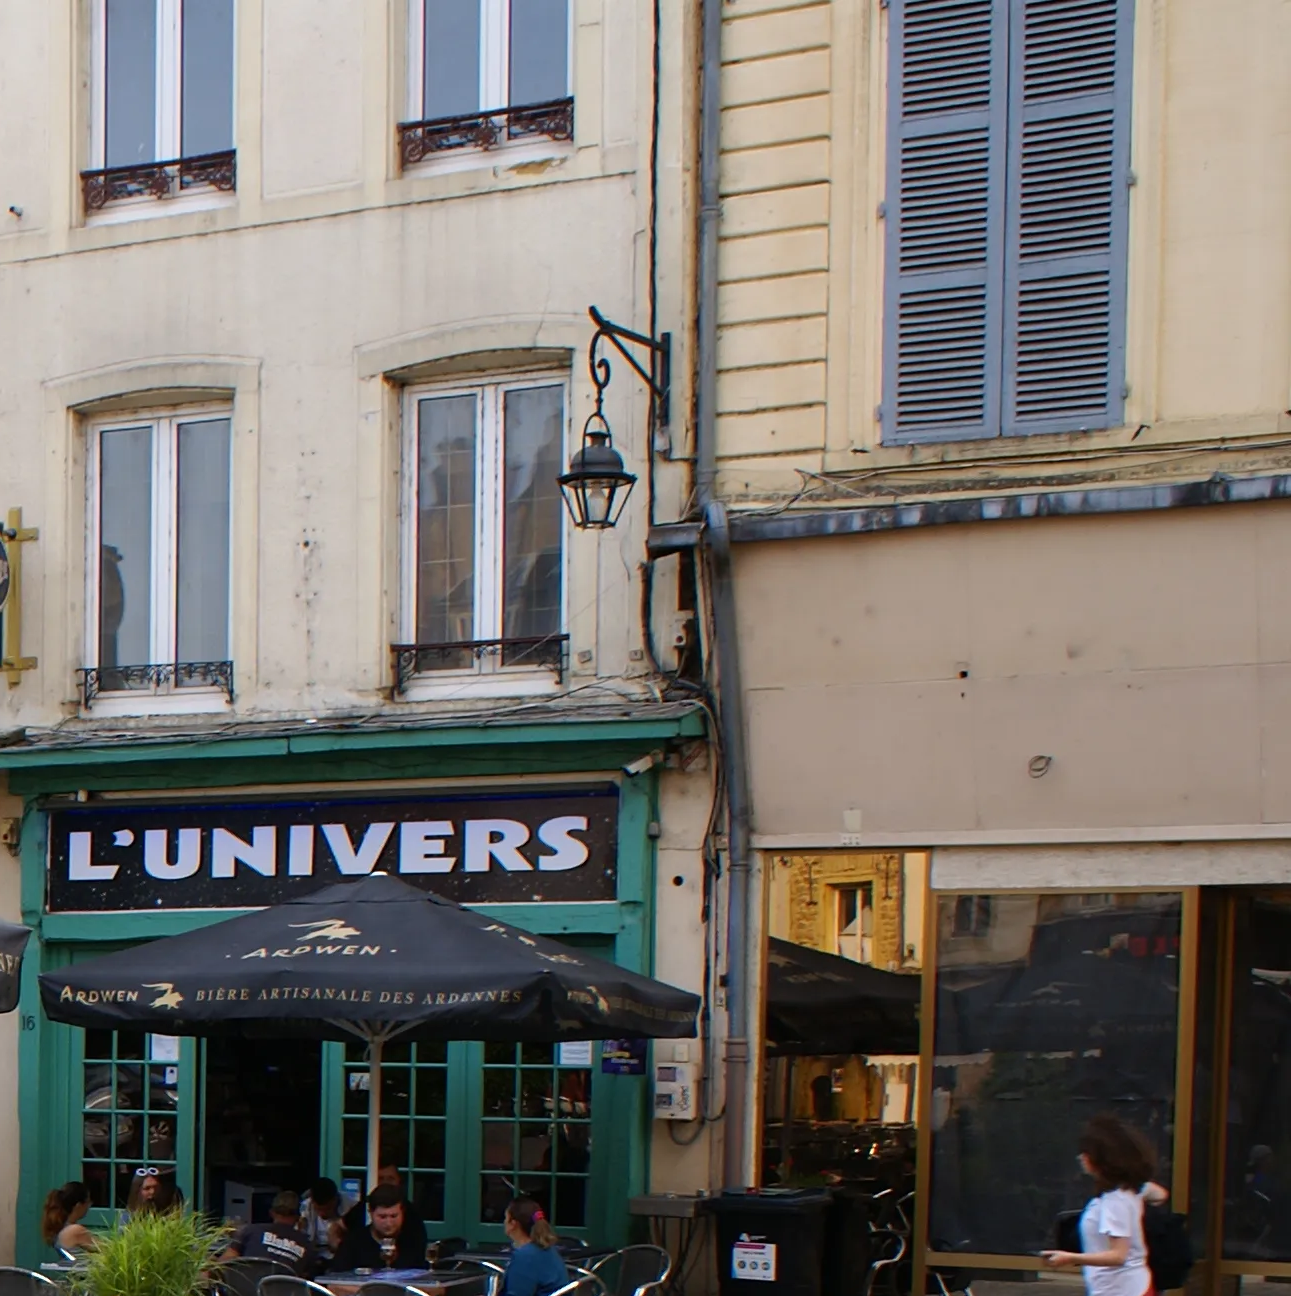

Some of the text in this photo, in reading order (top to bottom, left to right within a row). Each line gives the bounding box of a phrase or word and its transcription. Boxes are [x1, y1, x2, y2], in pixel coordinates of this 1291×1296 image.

[68, 815, 591, 882] L'UNIVERS
[240, 944, 380, 960] ARDWEN
[59, 985, 521, 1007] ARDWEN BIÈRE ARTISANALE DES ARDENNES
[21, 1015, 35, 1031] 16
